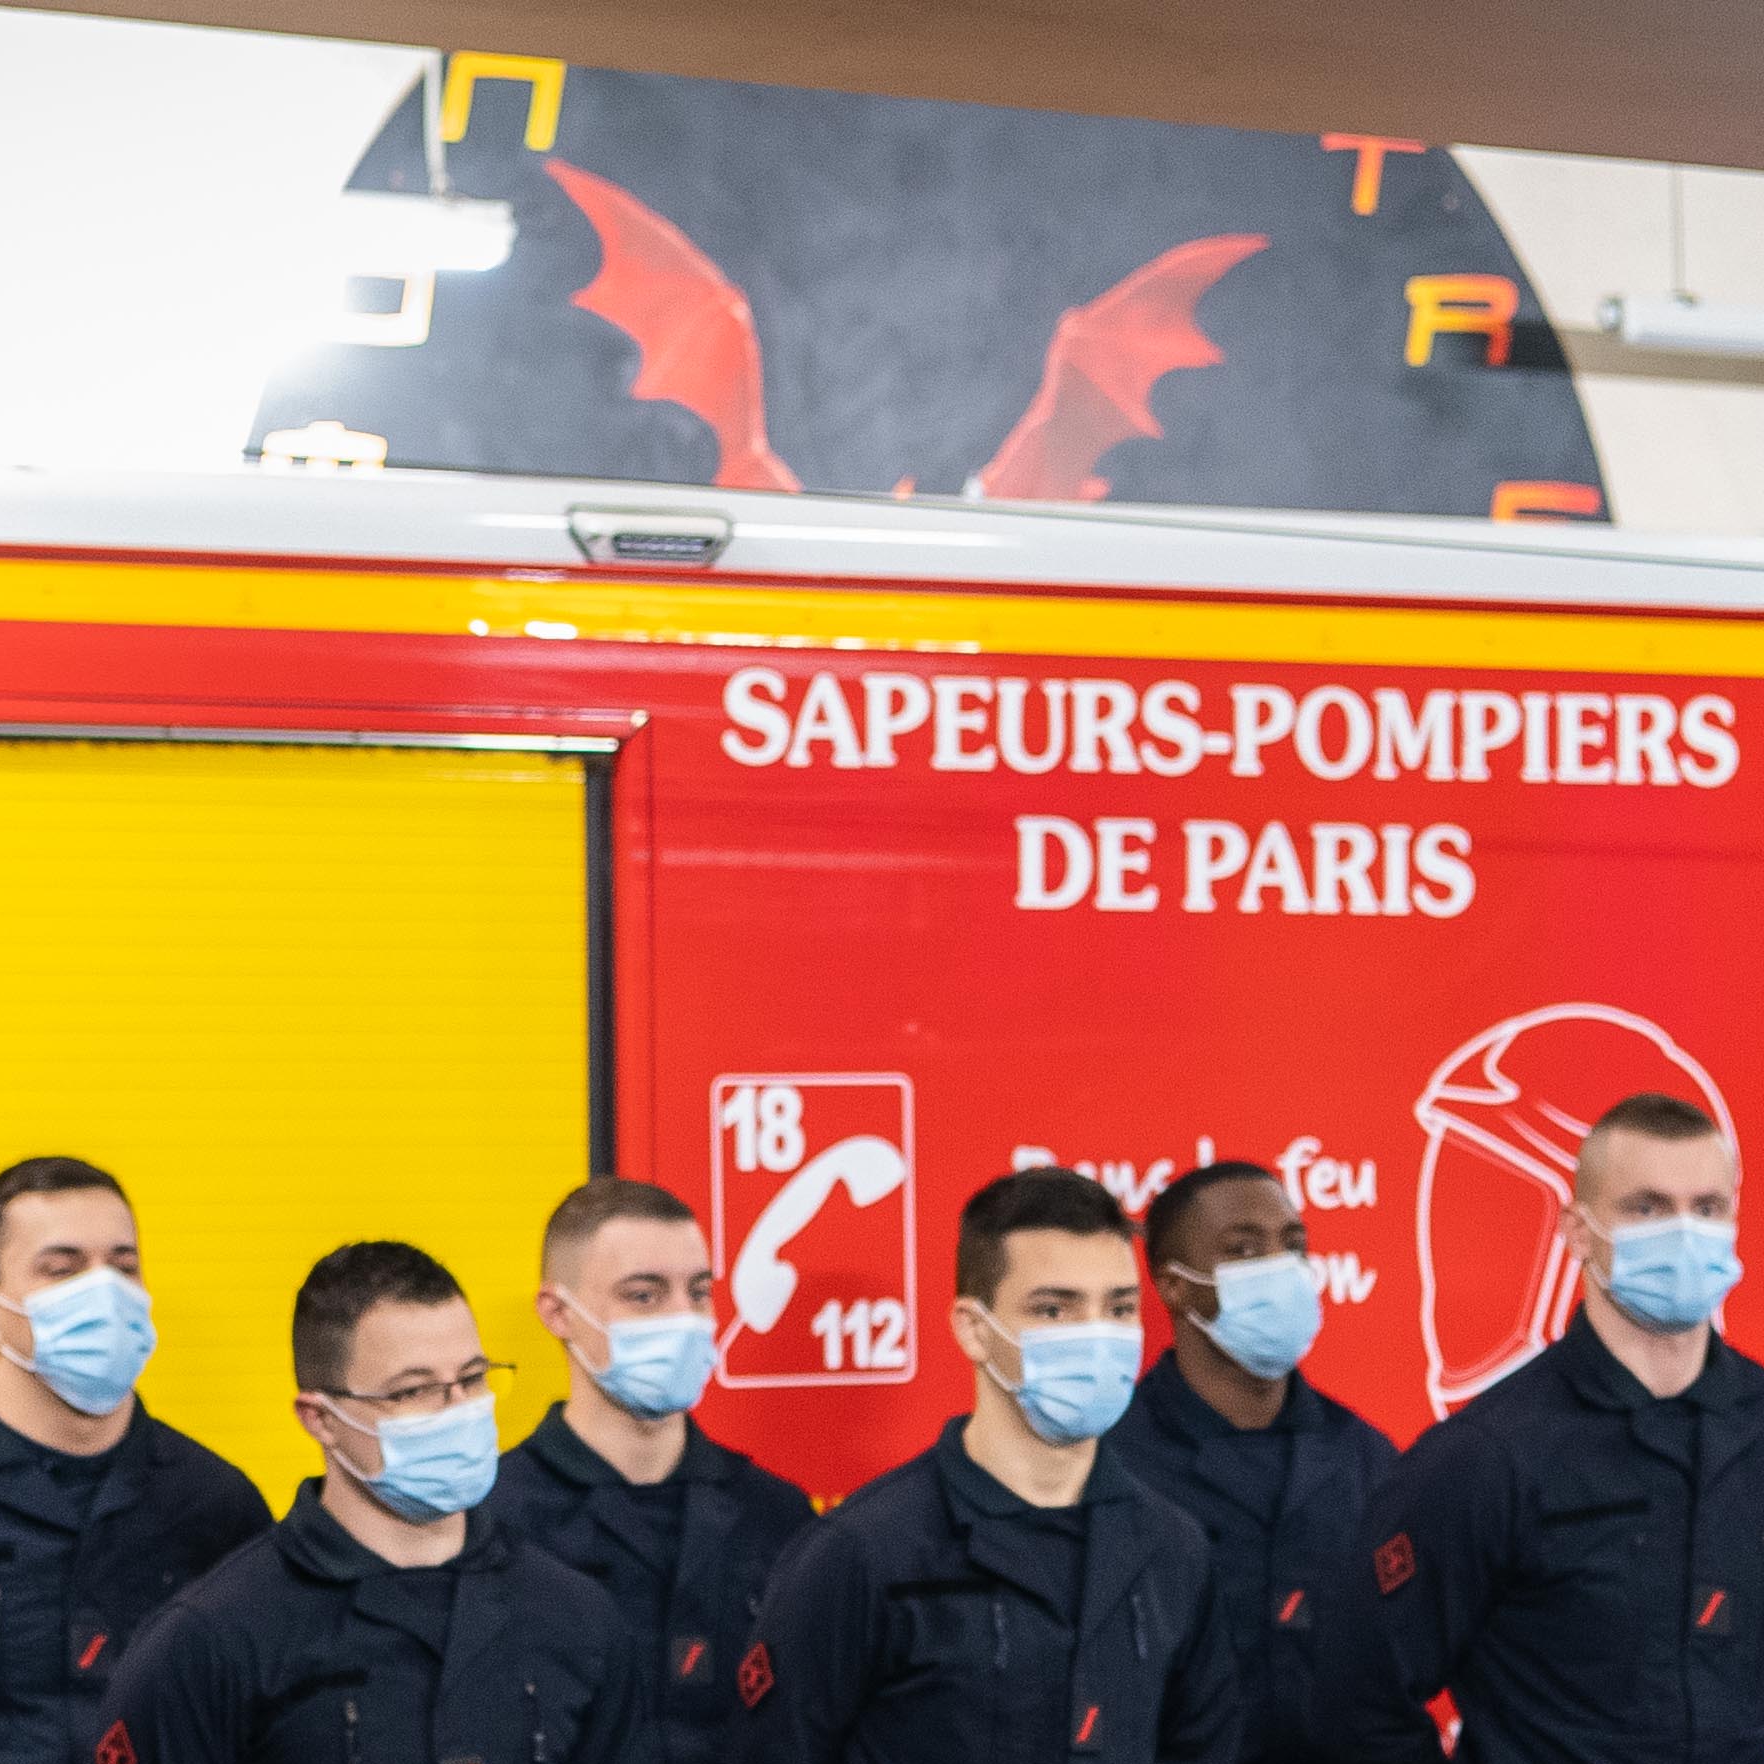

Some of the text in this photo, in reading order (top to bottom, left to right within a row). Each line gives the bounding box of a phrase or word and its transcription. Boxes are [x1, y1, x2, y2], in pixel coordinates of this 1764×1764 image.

[720, 666, 1740, 790] SAPEURS-POMPIERS
[1013, 814, 1476, 919] DE PARIS
[722, 1083, 806, 1172] 18
[1276, 1135, 1378, 1213] feu
[812, 1298, 907, 1371] 112
